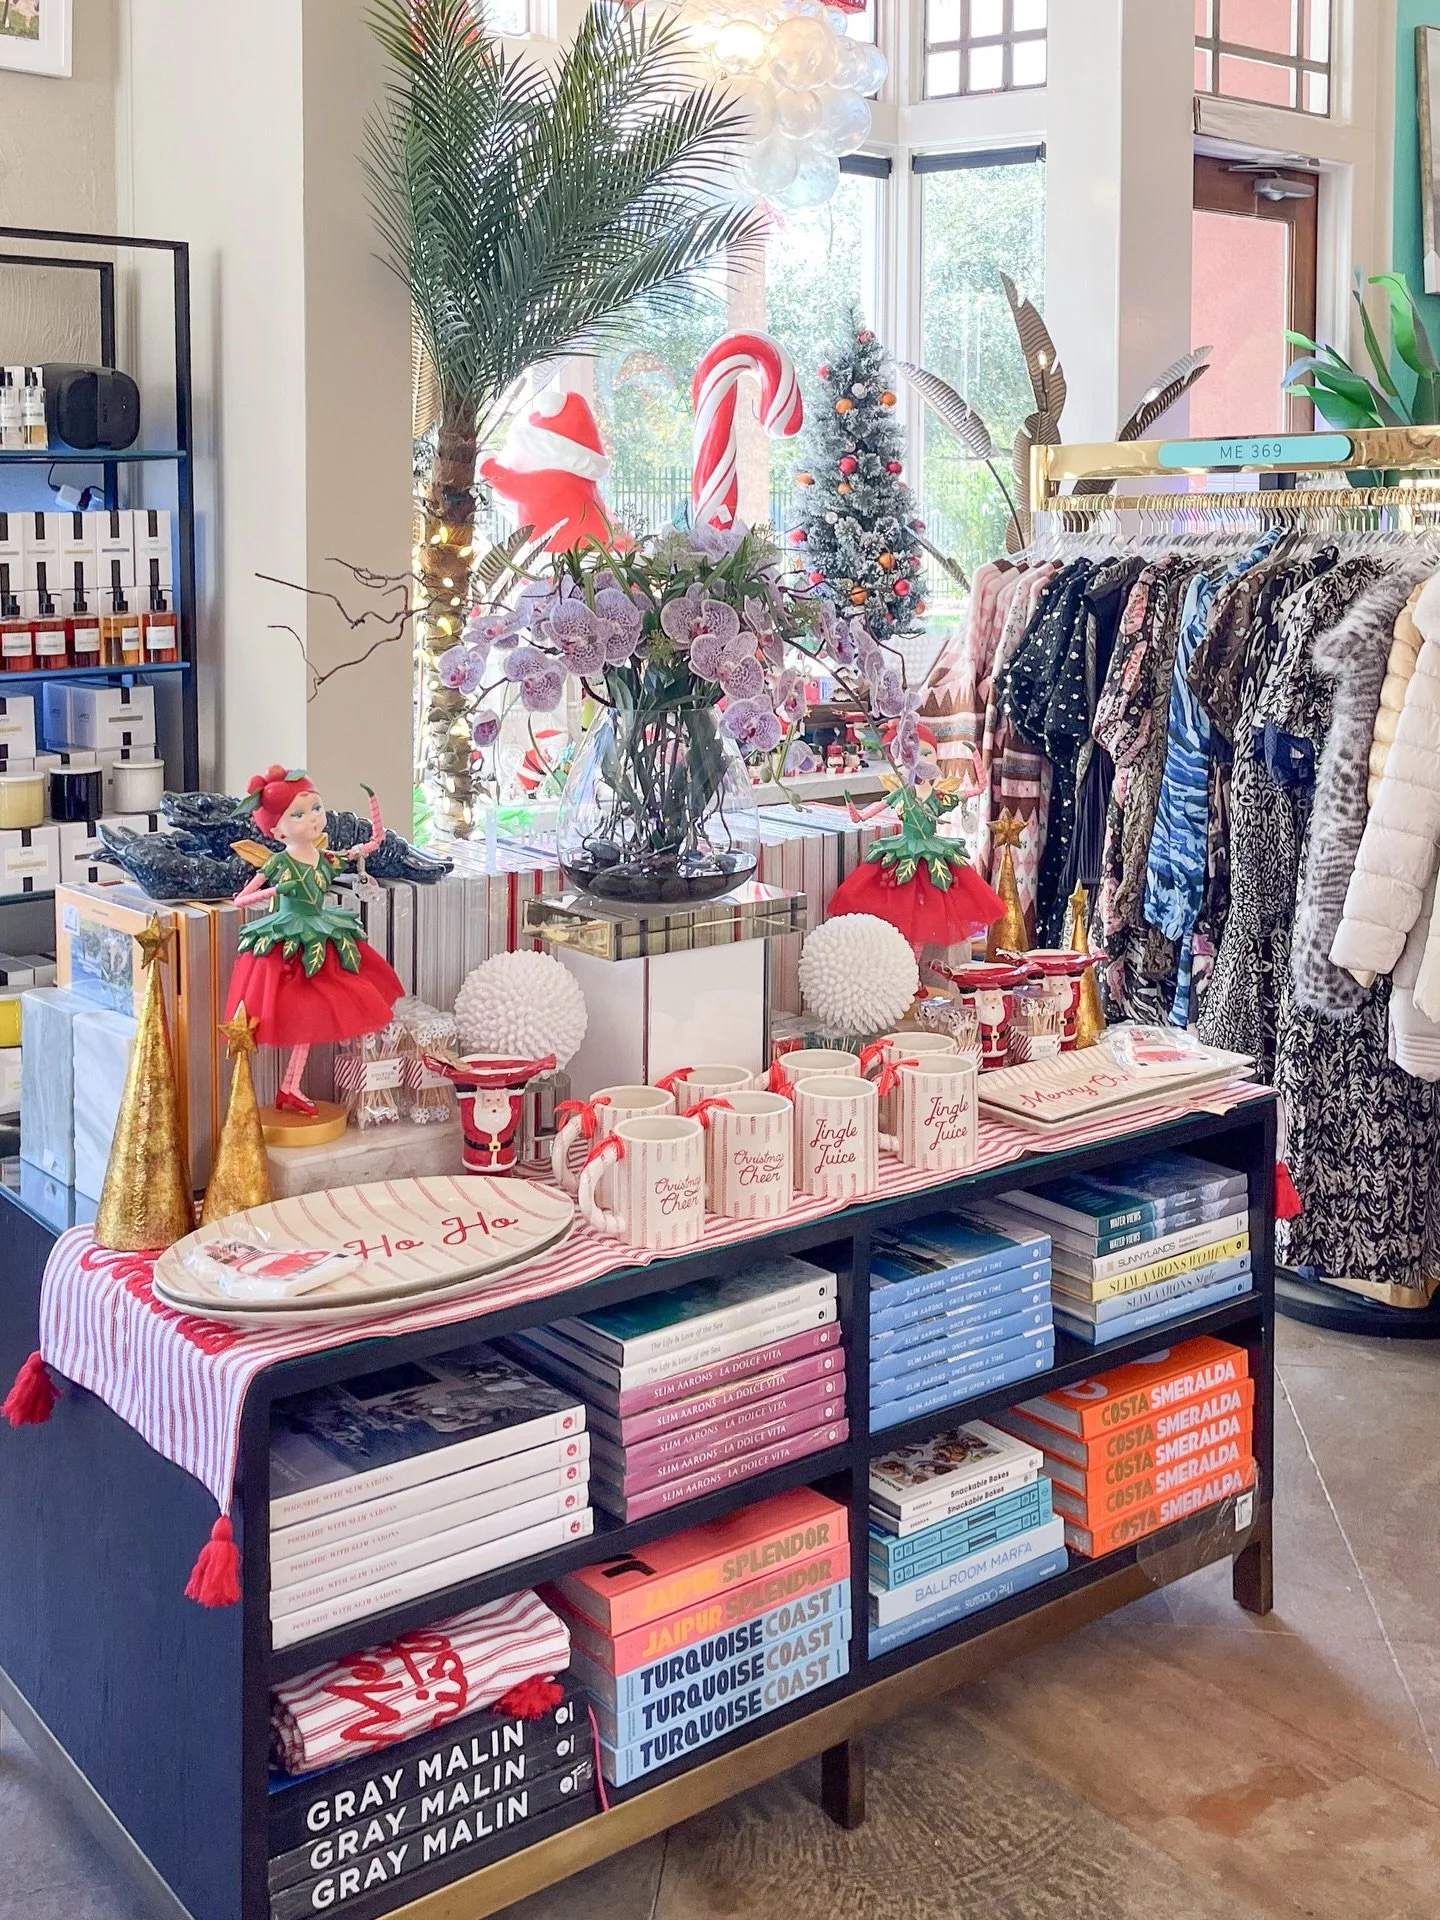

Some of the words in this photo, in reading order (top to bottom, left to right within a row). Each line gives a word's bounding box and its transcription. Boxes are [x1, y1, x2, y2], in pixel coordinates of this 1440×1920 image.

[1220, 445, 1243, 459] ME
[1251, 443, 1282, 458] 369
[924, 1096, 968, 1125] Jingle
[1022, 1084, 1098, 1109] Merry
[810, 1119, 858, 1148] Jingle
[929, 1122, 968, 1150] Juice
[739, 1165, 781, 1186] Cheer
[814, 1143, 856, 1174] Juice
[660, 1192, 698, 1215] Cheer
[343, 1234, 424, 1259] Ho
[441, 1211, 519, 1245] Ho
[1109, 1275, 1138, 1293] SLIM
[1141, 1260, 1186, 1282] AARONS
[1189, 1244, 1229, 1266] WOMEN
[1118, 1242, 1175, 1268] SUNNYLANDS
[906, 1287, 919, 1296] SLIM
[921, 1280, 945, 1291] AARONS
[950, 1274, 965, 1282] ONCE
[967, 1269, 982, 1278] UPON
[989, 1261, 1002, 1270] TIME
[1126, 1293, 1151, 1309] SLIM
[1152, 1278, 1193, 1300] AARONS
[904, 1309, 919, 1320] SLIM
[920, 1302, 944, 1314] AARONS
[949, 1295, 964, 1305] ONCE
[966, 1291, 982, 1299] UPON
[989, 1284, 1001, 1293] TIME
[651, 1342, 661, 1351] The
[713, 1321, 723, 1329] Sea
[905, 1335, 919, 1344] SLIM
[921, 1327, 944, 1339] AARONS
[949, 1320, 964, 1330] ONCE
[966, 1315, 981, 1325] UPON
[988, 1308, 1001, 1318] TIME
[907, 1356, 922, 1366] SLIM
[923, 1348, 946, 1360] AARONS
[951, 1341, 967, 1350] ONCE
[968, 1336, 984, 1345] UPON
[991, 1329, 1003, 1338] TIME
[648, 1367, 658, 1375] The
[654, 1387, 675, 1398] SLIM
[677, 1372, 713, 1390] AARONS
[719, 1367, 730, 1377] LA
[732, 1356, 761, 1373] DOLCE
[762, 1349, 782, 1363] VITA
[906, 1382, 919, 1391] SLIM
[922, 1373, 946, 1386] AARONS
[951, 1366, 966, 1377] ONCE
[968, 1360, 984, 1371] UPON
[991, 1353, 1004, 1363] TIME
[657, 1414, 678, 1426] SLIM
[681, 1399, 717, 1418] AARONS
[723, 1393, 734, 1404] LA
[736, 1383, 764, 1399] DOLCE
[766, 1376, 786, 1389] VITA
[908, 1403, 923, 1413] SLIM
[924, 1394, 948, 1407] AARONS
[952, 1387, 968, 1397] ONCE
[969, 1382, 984, 1391] UPON
[992, 1374, 1005, 1384] TIME
[1102, 1392, 1150, 1426] COSTA
[1151, 1360, 1236, 1409] SMERALDA
[660, 1441, 680, 1453] SLIM
[682, 1426, 718, 1445] AARONS
[725, 1418, 735, 1429] LA
[738, 1408, 766, 1425] DOLCE
[767, 1400, 787, 1414] VITA
[1106, 1423, 1154, 1458] COSTA
[1156, 1389, 1242, 1440] SMERALDA
[657, 1464, 679, 1477] SLIM
[682, 1450, 717, 1469] AARONS
[724, 1444, 734, 1454] LA
[737, 1433, 765, 1449] DOLCE
[767, 1425, 786, 1438] VITA
[1106, 1451, 1153, 1485] COSTA
[1155, 1415, 1240, 1466] SMERALDA
[662, 1490, 684, 1502] SLIM
[686, 1475, 721, 1494] AARONS
[728, 1469, 738, 1478] LA
[741, 1457, 769, 1473] DOLCE
[771, 1449, 790, 1462] VITA
[951, 1479, 987, 1498] Snackable
[989, 1471, 1009, 1483] Bakes
[1106, 1478, 1153, 1513] COSTA
[1155, 1441, 1240, 1493] SMERALDA
[323, 1491, 343, 1501] WITH
[948, 1495, 984, 1514] Snackable
[985, 1485, 1004, 1499] Bakes
[1110, 1508, 1158, 1543] COSTA
[1160, 1470, 1243, 1522] SMERALDA
[327, 1521, 347, 1531] WITH
[330, 1548, 350, 1558] WITH
[639, 1568, 721, 1619] JAIPUR
[723, 1522, 830, 1583] SPLENDOR
[328, 1578, 347, 1588] WITH
[915, 1564, 987, 1601] BALLROOM
[991, 1542, 1032, 1569] MARFA
[1000, 1581, 1014, 1595] The
[333, 1606, 352, 1616] WITH
[642, 1605, 723, 1658] JAIPUR
[725, 1559, 832, 1621] SPLENDOR
[965, 1590, 997, 1608] Oceans
[641, 1619, 763, 1696] TURQUOISE
[765, 1588, 832, 1637] COAST
[642, 1652, 764, 1730] TURQUOISE
[766, 1622, 833, 1671] COAST
[640, 1687, 762, 1768] TURQUOISE
[764, 1654, 830, 1706] COAST
[306, 1769, 404, 1832] GRAY
[418, 1720, 524, 1788] MALIN
[310, 1806, 407, 1870] GRAY
[421, 1754, 526, 1823] MALIN
[311, 1844, 409, 1909] GRAY
[423, 1791, 528, 1862] MALIN
